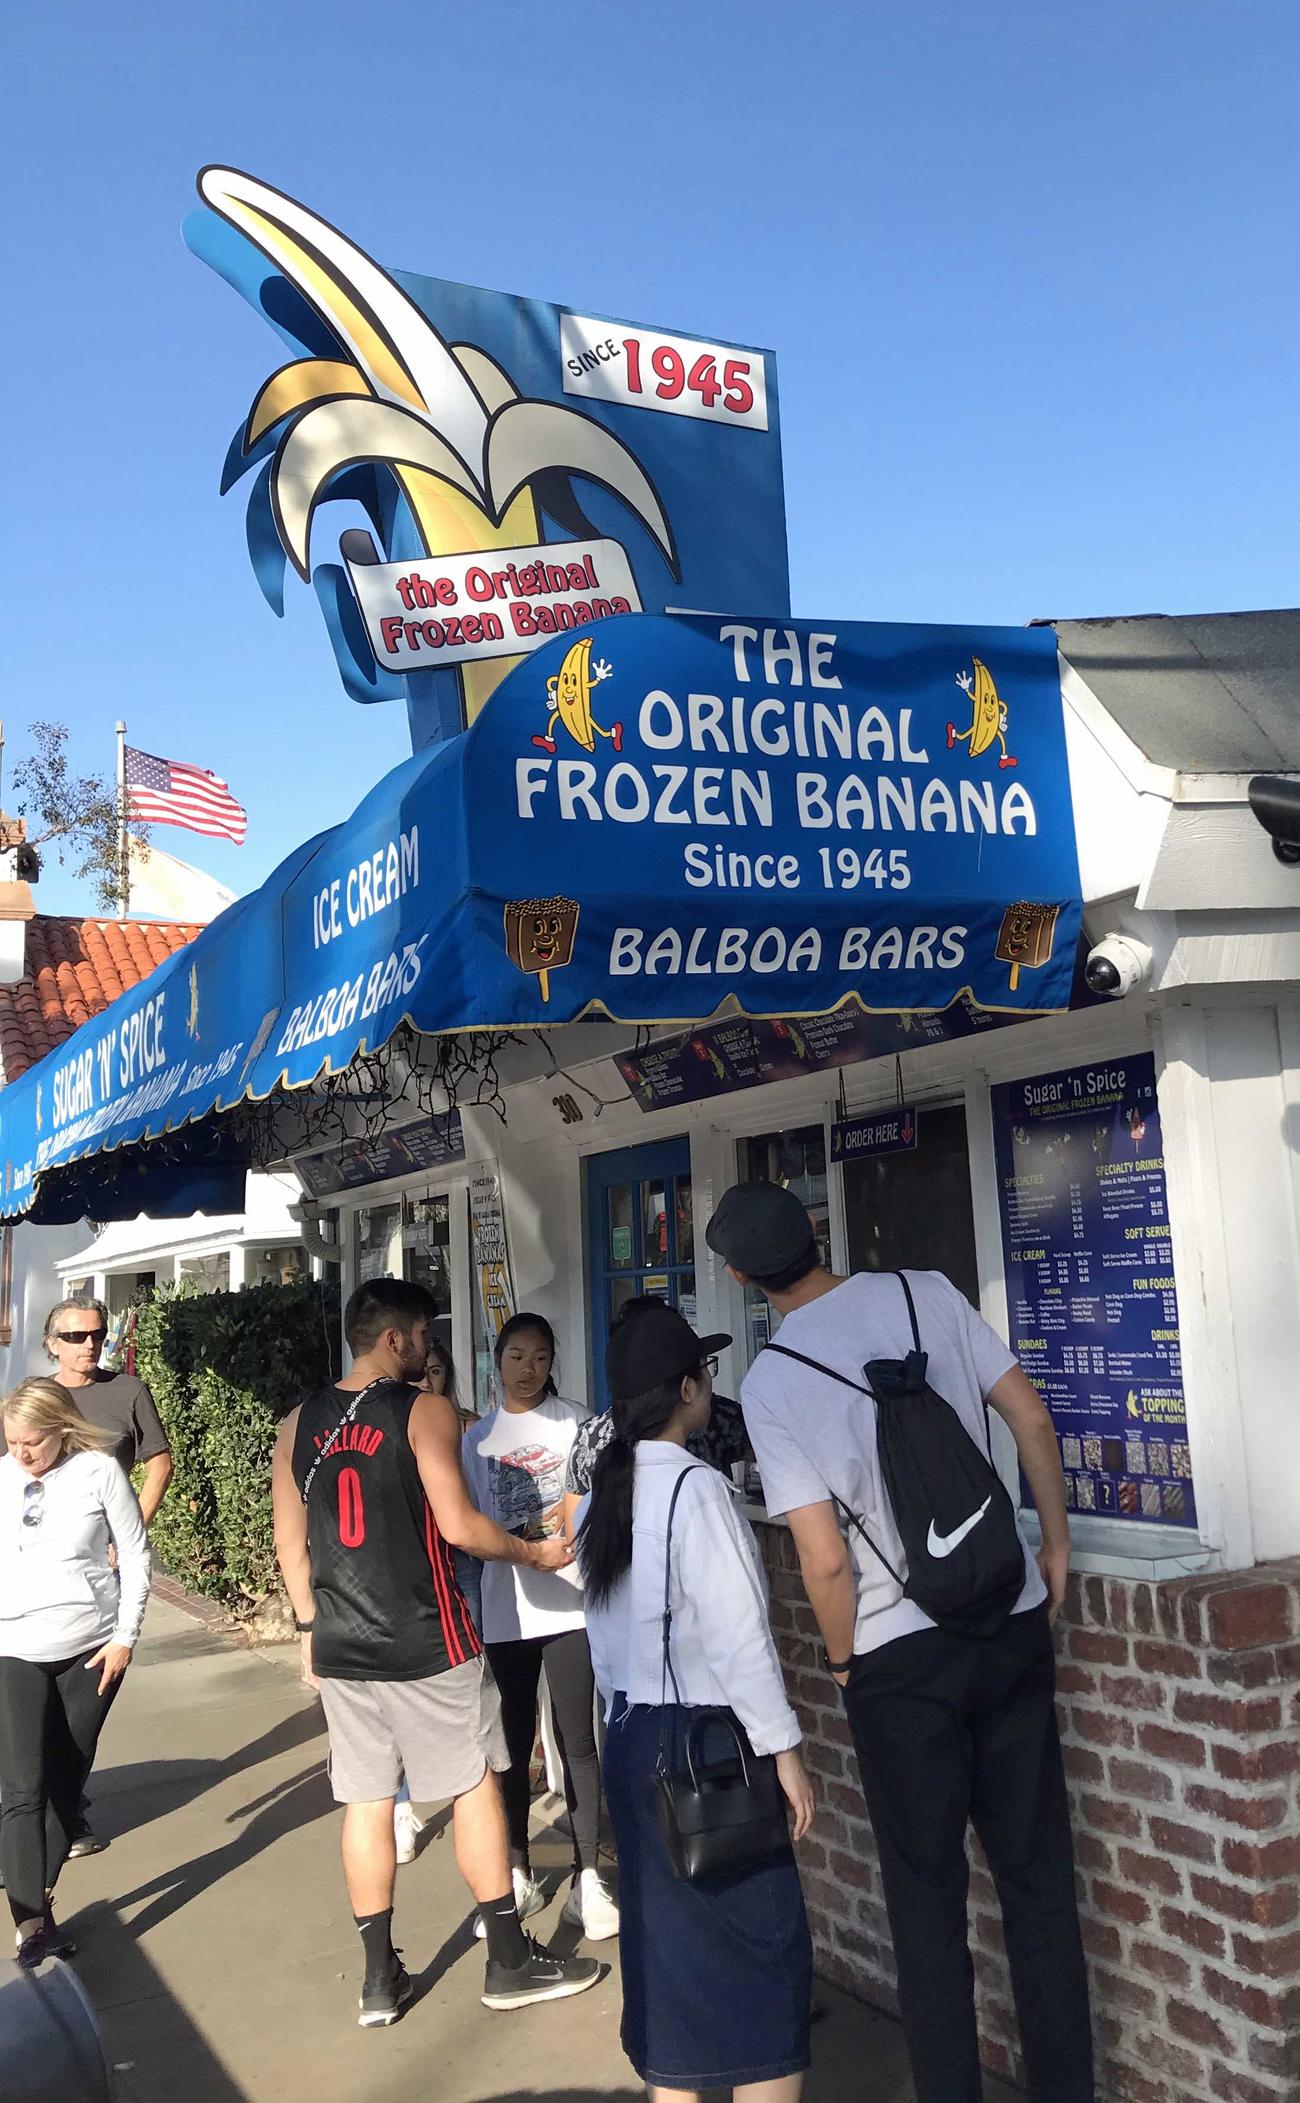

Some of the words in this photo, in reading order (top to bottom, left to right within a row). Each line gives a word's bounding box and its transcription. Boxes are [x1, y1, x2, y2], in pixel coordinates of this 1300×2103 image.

[567, 337, 620, 378] SINCE
[622, 338, 755, 415] 1945
[396, 573, 458, 610] the
[465, 554, 600, 602] Original
[380, 611, 504, 653] Frozen
[719, 624, 843, 690] THE
[638, 690, 930, 764] ORIGINAL
[514, 757, 773, 828] FROZEN
[797, 772, 1038, 836] BANANA
[683, 842, 801, 889] Since
[817, 846, 912, 890] 1945
[313, 872, 343, 949] ICE
[346, 825, 420, 924] CREAM
[609, 926, 823, 976] BALBOA
[839, 924, 968, 971] BARS
[275, 973, 364, 1057] BALBOA
[360, 933, 430, 1020] BARS
[52, 1048, 94, 1128] SUGAR
[120, 992, 167, 1088] SPICE
[1024, 1083, 1062, 1106] Sugar
[1086, 1069, 1126, 1094] Spice
[1071, 1096, 1096, 1109] FROZEN
[1096, 1092, 1124, 1104] BANANA
[552, 1094, 584, 1124] 30
[846, 1127, 874, 1149] ORDER
[875, 1122, 898, 1143] HERE
[1096, 1162, 1134, 1176] SPECIALTY
[1135, 1158, 1165, 1172] DRINKS
[1124, 1228, 1144, 1240] SOFT
[1146, 1225, 1170, 1238] SERVE
[1011, 1252, 1022, 1262] ICE
[1023, 1249, 1046, 1260] CREAM
[1133, 1278, 1148, 1290] FUN
[1150, 1277, 1176, 1290] FOODS
[1018, 1338, 1048, 1350] SUNDAES
[1151, 1330, 1180, 1340] DRINKS
[347, 1389, 368, 1416] adidas
[1140, 1388, 1152, 1396] ASK
[1152, 1388, 1172, 1397] ABOUT
[1141, 1398, 1184, 1413] TOPPING
[1143, 1414, 1151, 1422] OF
[1152, 1414, 1164, 1423] THE
[1164, 1414, 1186, 1424] MONTH
[320, 1427, 341, 1456] adidas
[304, 1466, 316, 1494] adidas
[337, 1466, 366, 1548] 0
